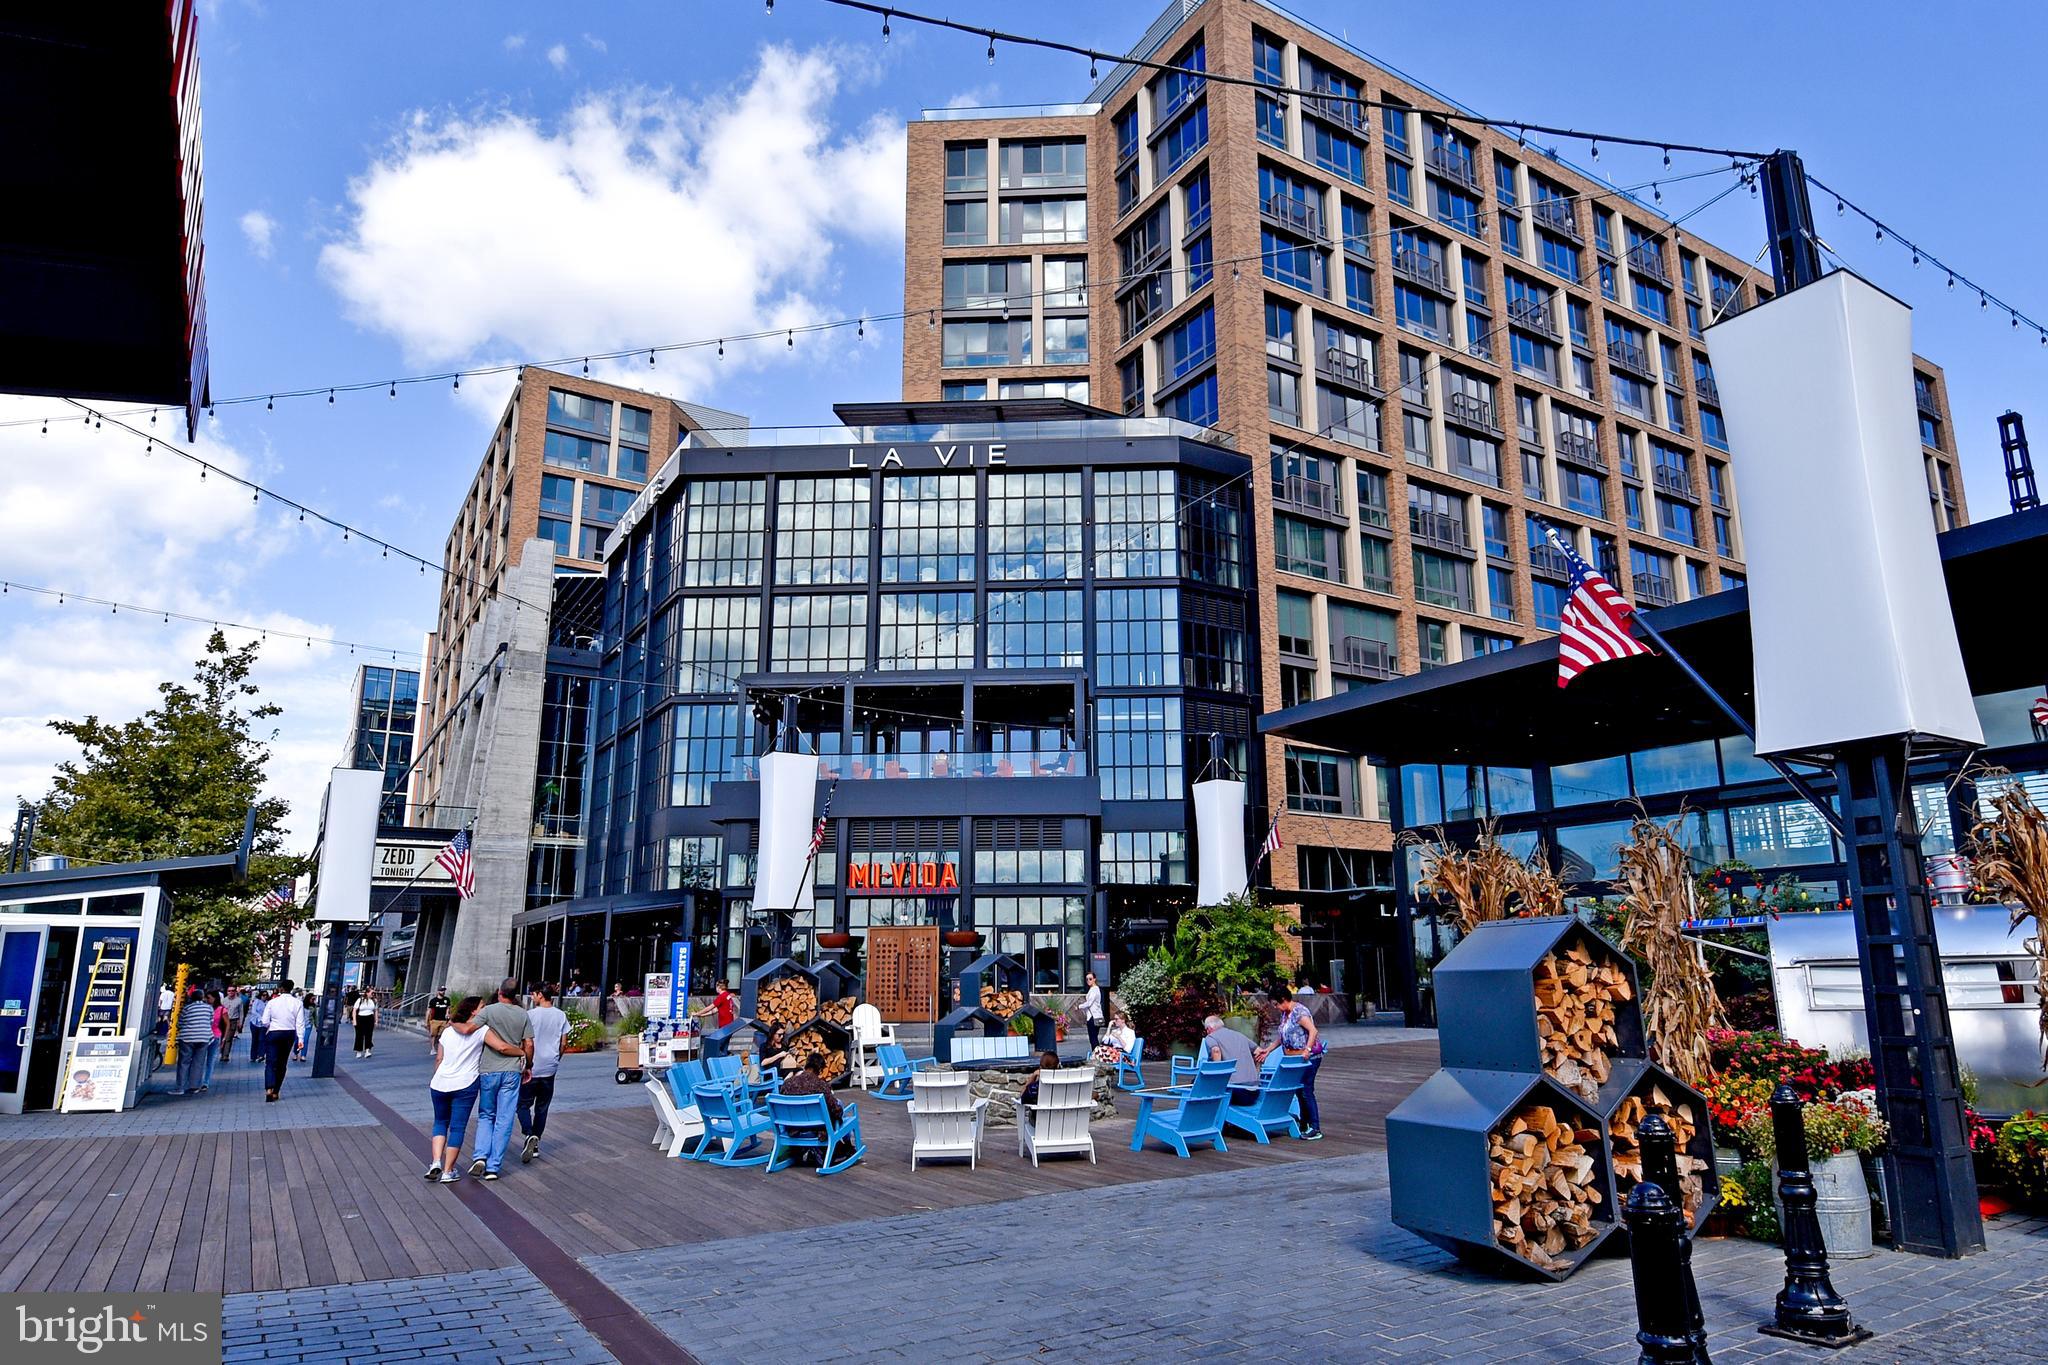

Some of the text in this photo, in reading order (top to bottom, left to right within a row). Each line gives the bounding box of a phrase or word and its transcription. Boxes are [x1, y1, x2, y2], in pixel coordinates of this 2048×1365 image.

[848, 444, 1008, 469] LA VIE
[381, 848, 415, 865] ZEDD
[380, 867, 415, 877] TONIGHT
[890, 862, 958, 888] VIDA
[273, 960, 282, 981] RUM
[676, 947, 688, 1020] HARF EVENTS
[88, 1011, 110, 1021] SWAG!
